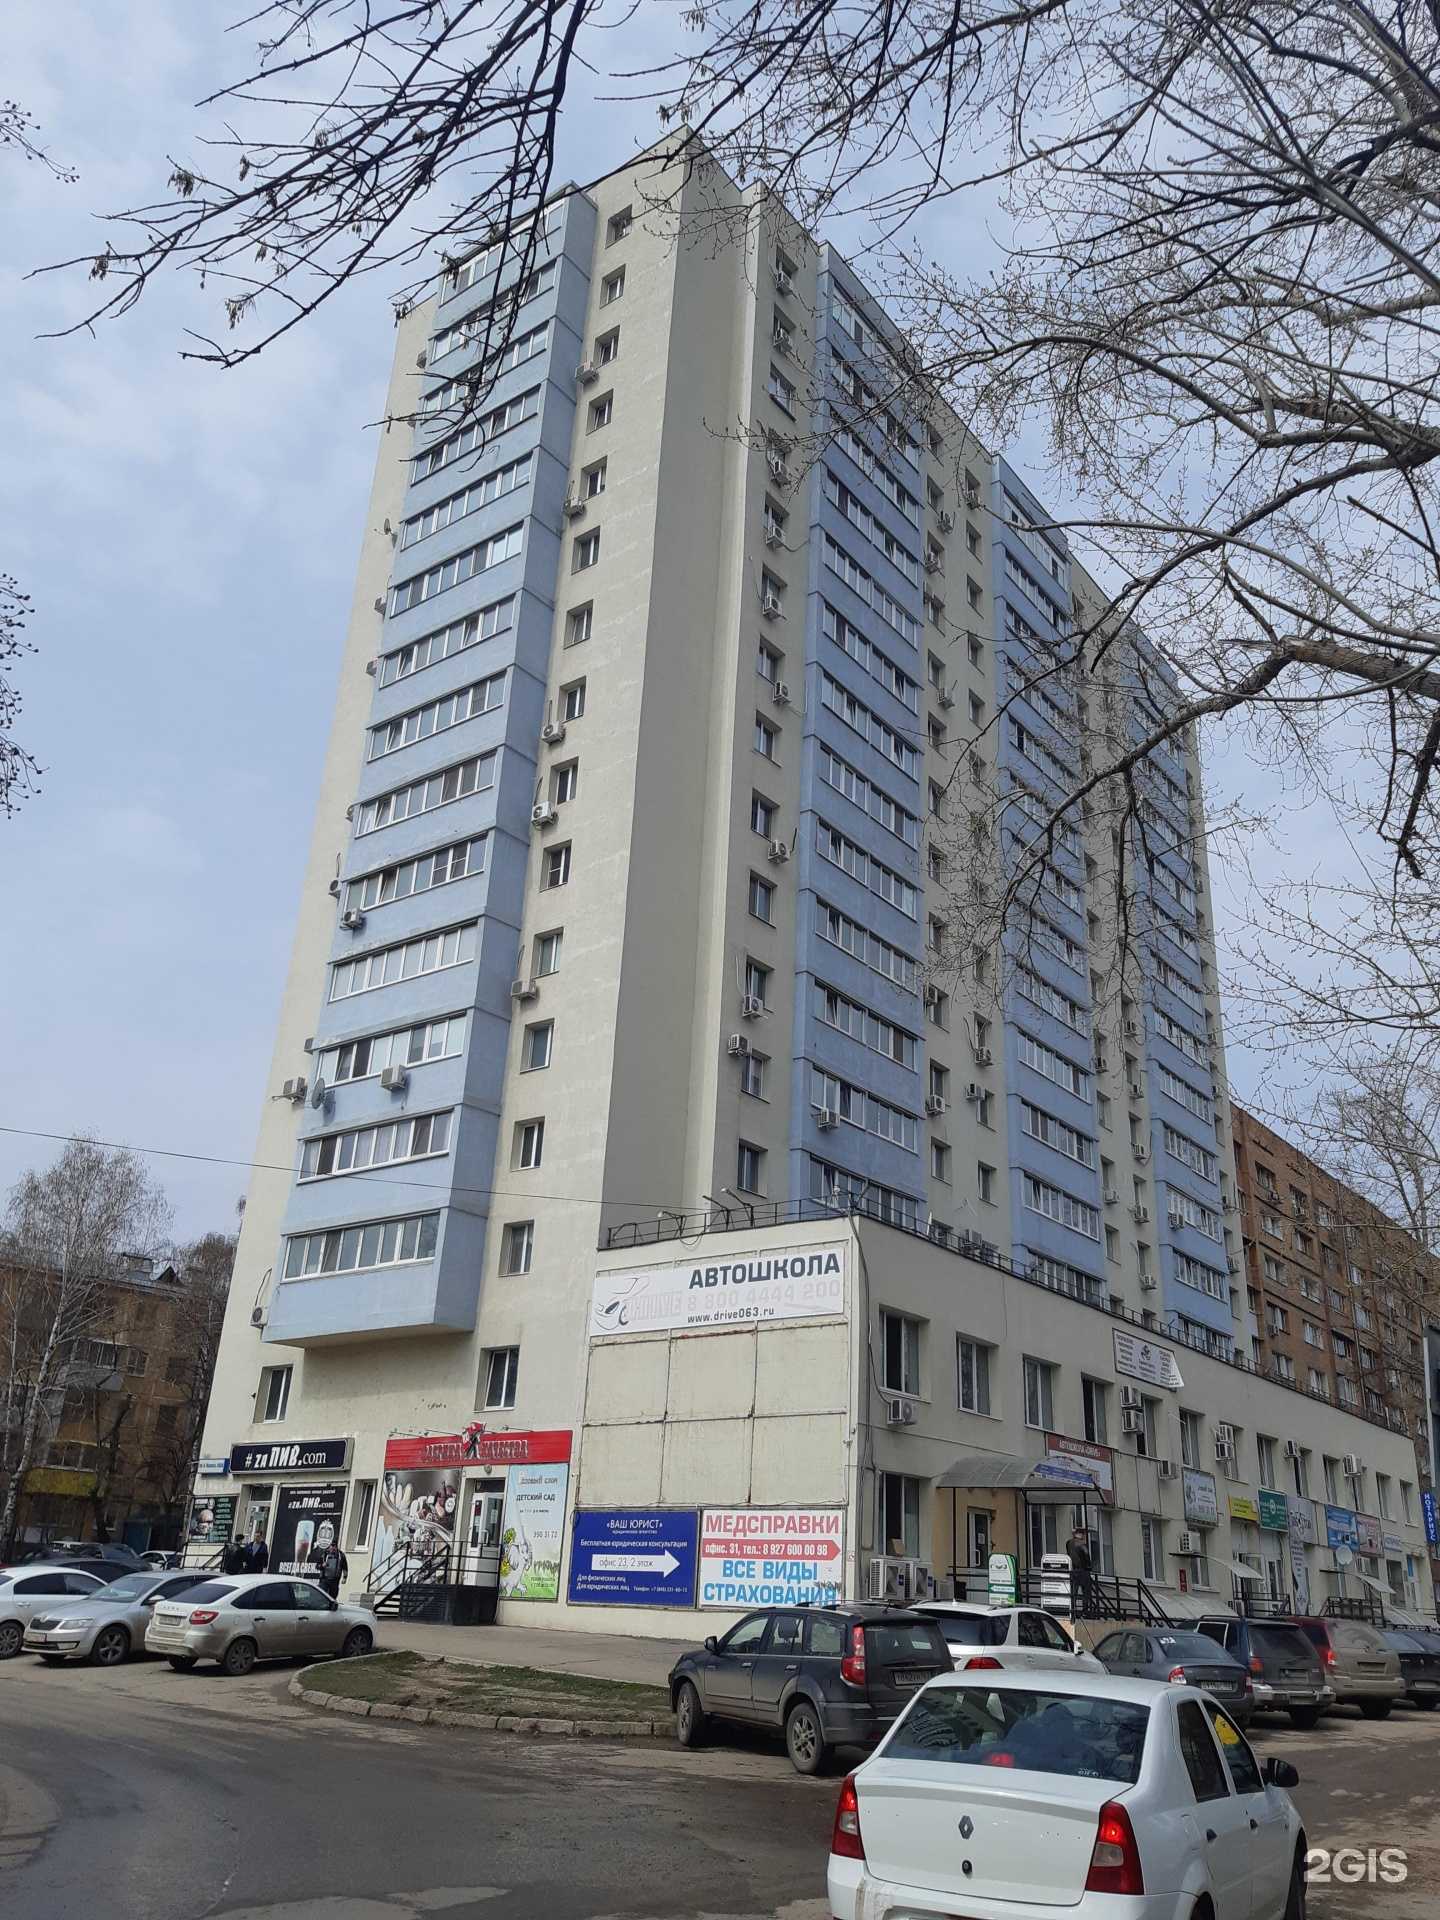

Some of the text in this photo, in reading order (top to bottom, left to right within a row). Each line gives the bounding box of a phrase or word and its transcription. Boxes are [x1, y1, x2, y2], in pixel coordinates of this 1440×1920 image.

[688, 1253, 840, 1289] АВТОШКОЛА
[687, 1307, 774, 1323] www.drive063.ru
[516, 1492, 556, 1502] ДЕТСКИЙ САД
[1424, 1493, 1436, 1541] НОТАРИУС
[705, 1515, 839, 1537] МЕДСПРАВКИ
[580, 1539, 611, 1547] Бесплатная
[763, 1544, 768, 1555] 8
[770, 1544, 785, 1555] 927
[637, 1560, 654, 1568] этаж
[577, 1574, 587, 1582] Для
[722, 1560, 818, 1584] ВСЕ ВИДЫ
[576, 1582, 587, 1590] Для
[703, 1582, 837, 1604] СТРАХОВАНИЯ
